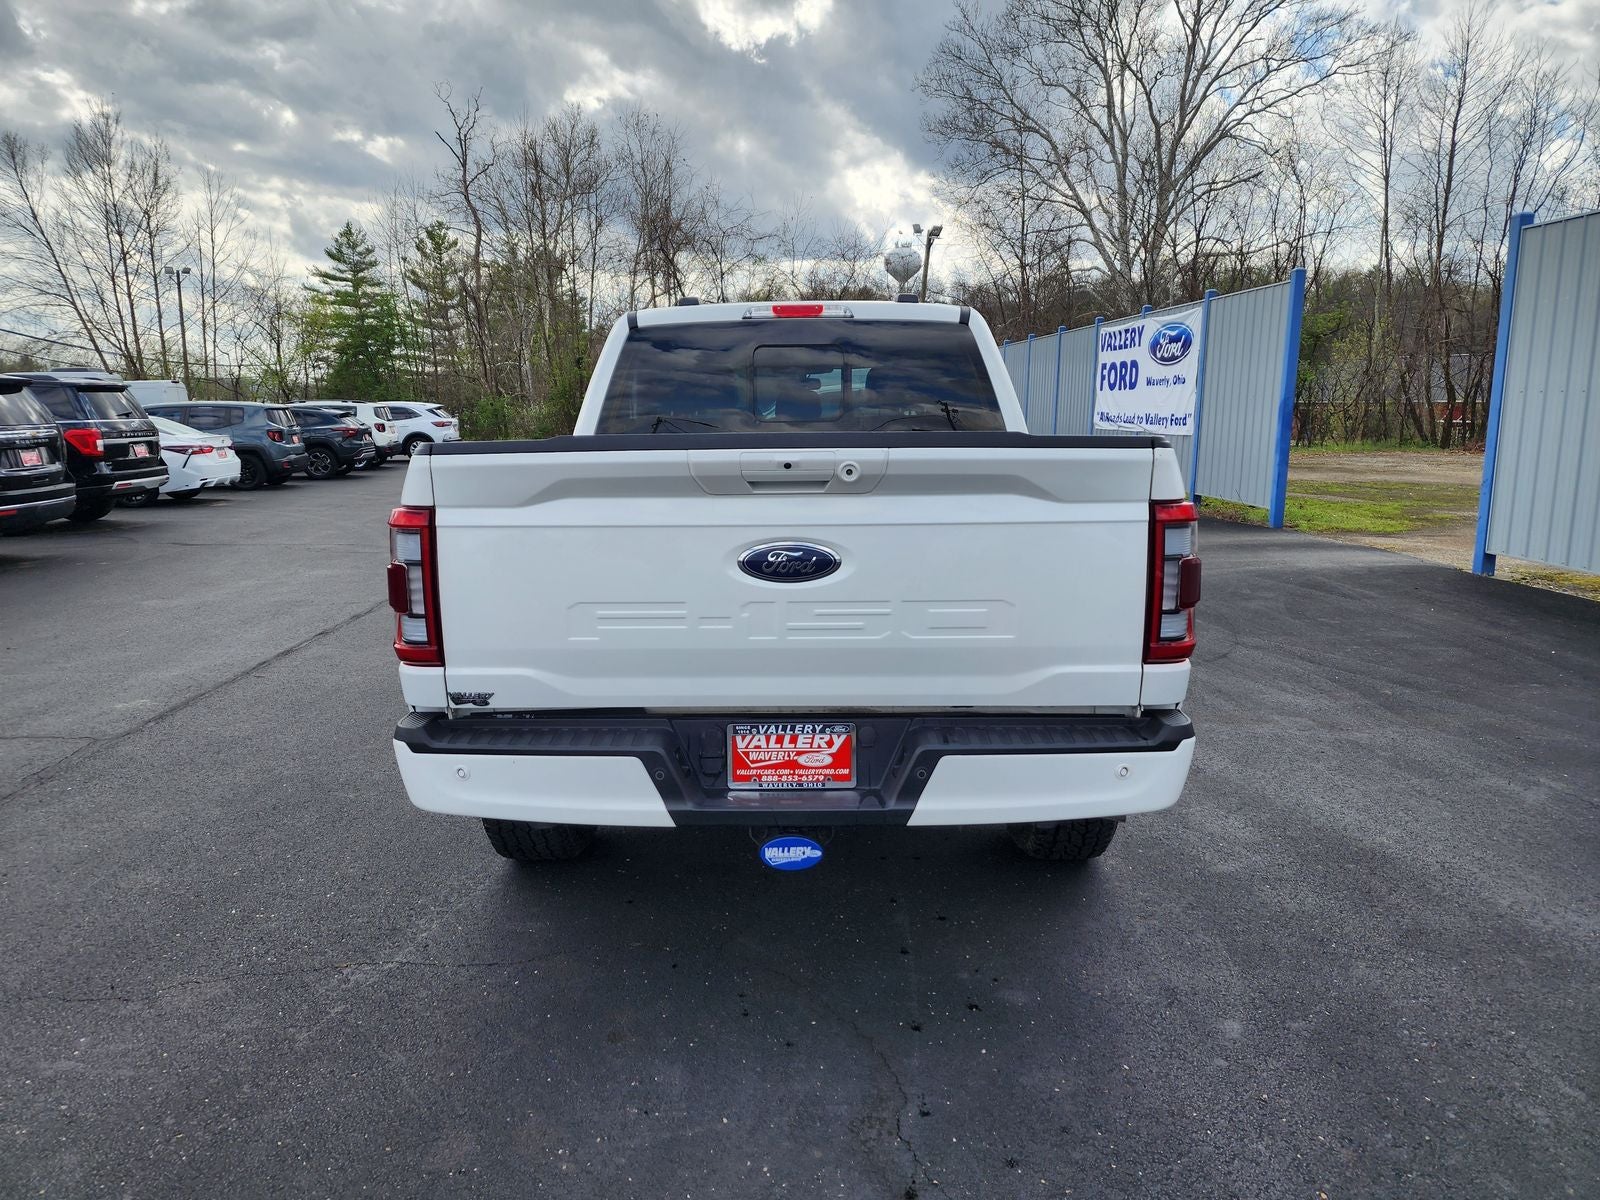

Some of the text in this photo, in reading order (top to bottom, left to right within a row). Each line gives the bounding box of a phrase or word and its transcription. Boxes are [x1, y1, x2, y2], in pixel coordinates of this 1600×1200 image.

[1101, 325, 1144, 352] VALLERY
[1156, 330, 1185, 358] Ford
[1100, 359, 1139, 391] FORD
[1172, 374, 1186, 385] Ohio
[1136, 414, 1144, 425] to
[1145, 412, 1168, 429] Vallery
[762, 550, 817, 573] Ford
[567, 600, 1017, 641] F-150
[758, 724, 824, 734] VALLERY
[736, 735, 847, 751] VALLERY
[804, 754, 826, 764] Ford
[765, 847, 811, 858] VALLERY
